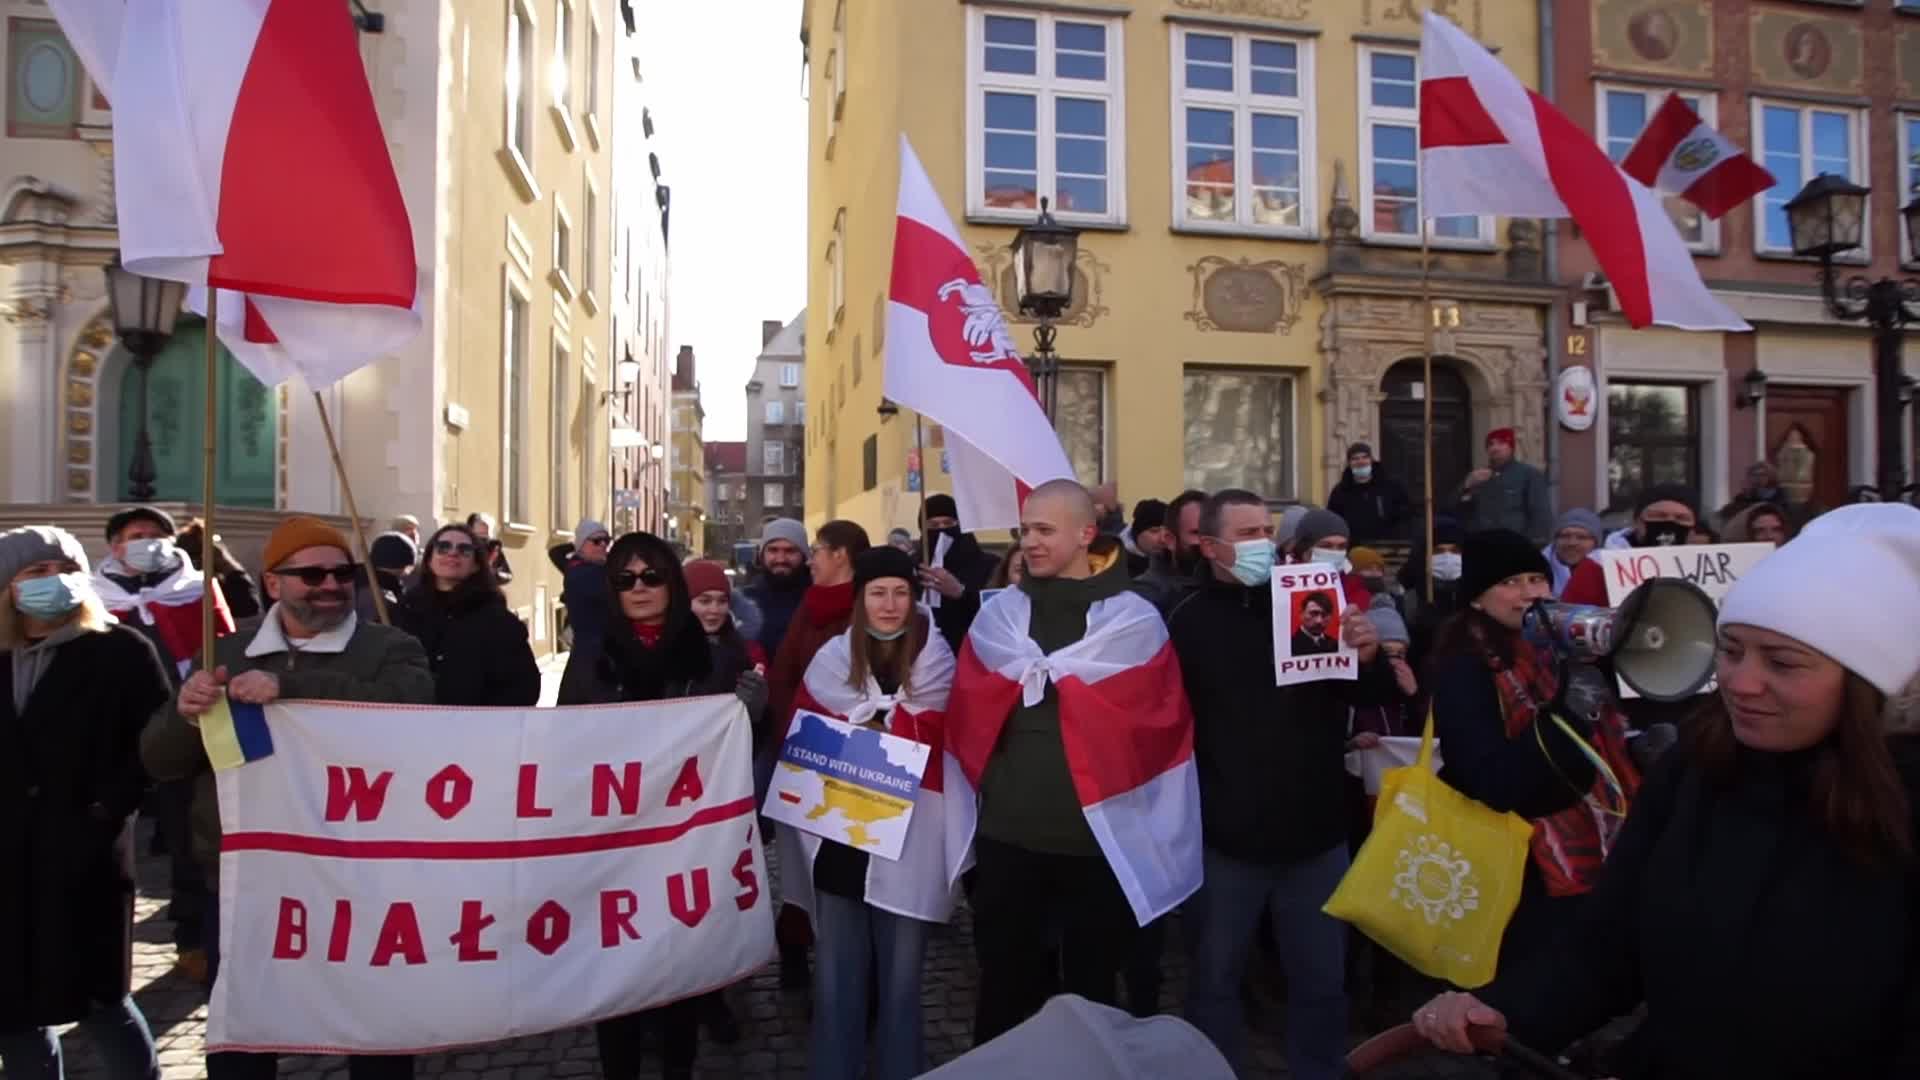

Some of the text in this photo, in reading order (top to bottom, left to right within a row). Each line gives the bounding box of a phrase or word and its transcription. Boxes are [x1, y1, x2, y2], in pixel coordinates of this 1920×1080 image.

[1432, 306, 1460, 327] 13
[1567, 335, 1586, 355] 12
[1280, 572, 1338, 588] STOP
[1615, 552, 1737, 587] NO WAR
[1281, 656, 1350, 673] PUTIN
[793, 747, 828, 766] STAND
[829, 759, 857, 775] WITH
[859, 768, 912, 792] UKRAINE
[325, 756, 704, 822] WOLNA
[272, 825, 759, 966] BIAŁORUŚ
